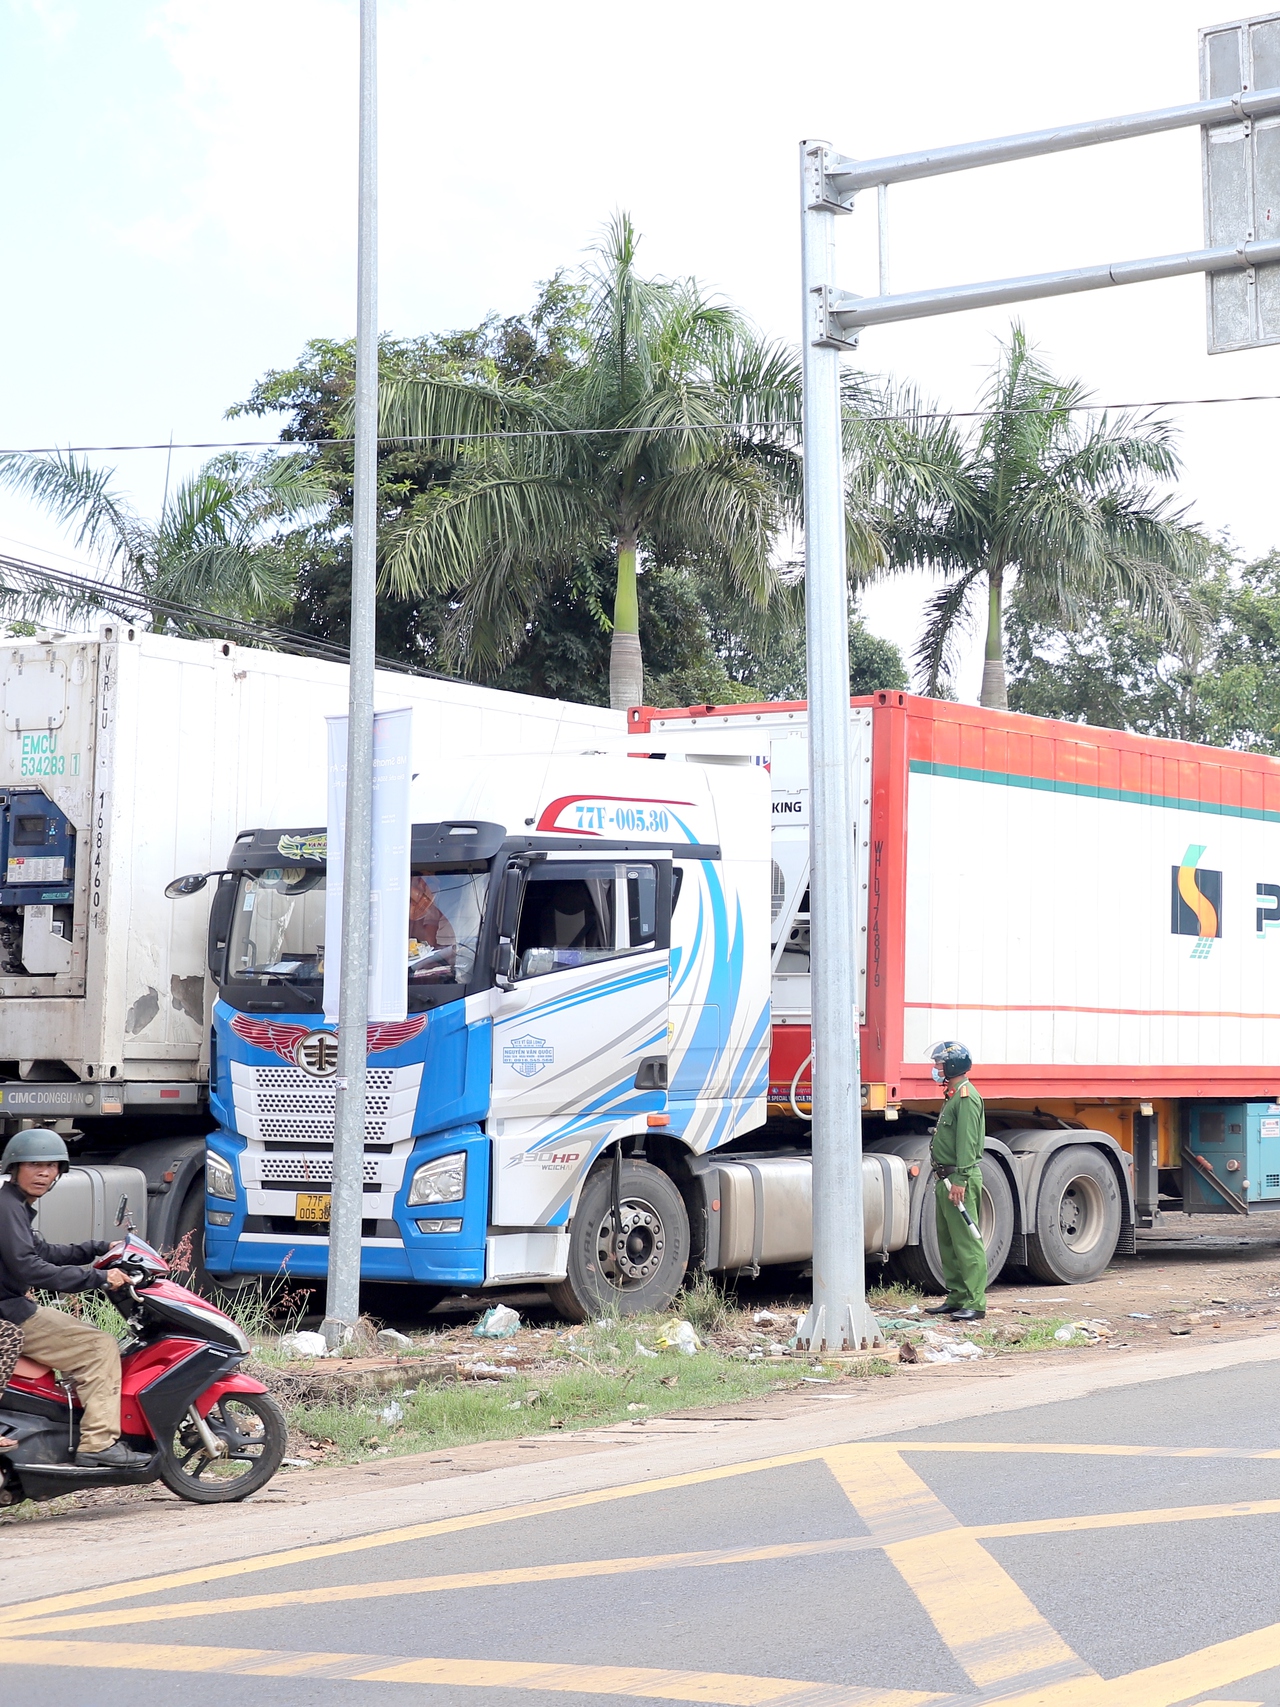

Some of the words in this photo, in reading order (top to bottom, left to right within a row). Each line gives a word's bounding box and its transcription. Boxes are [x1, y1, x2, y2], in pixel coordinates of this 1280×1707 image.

[22, 734, 58, 755] EMCU
[21, 755, 66, 777] 534283
[772, 801, 802, 814] KING
[575, 805, 669, 833] 77F-005.30
[8, 1092, 37, 1104] CIMC
[37, 1092, 84, 1104] DONGGUAN
[508, 1152, 580, 1164] 430HP
[307, 1195, 323, 1207] 77F
